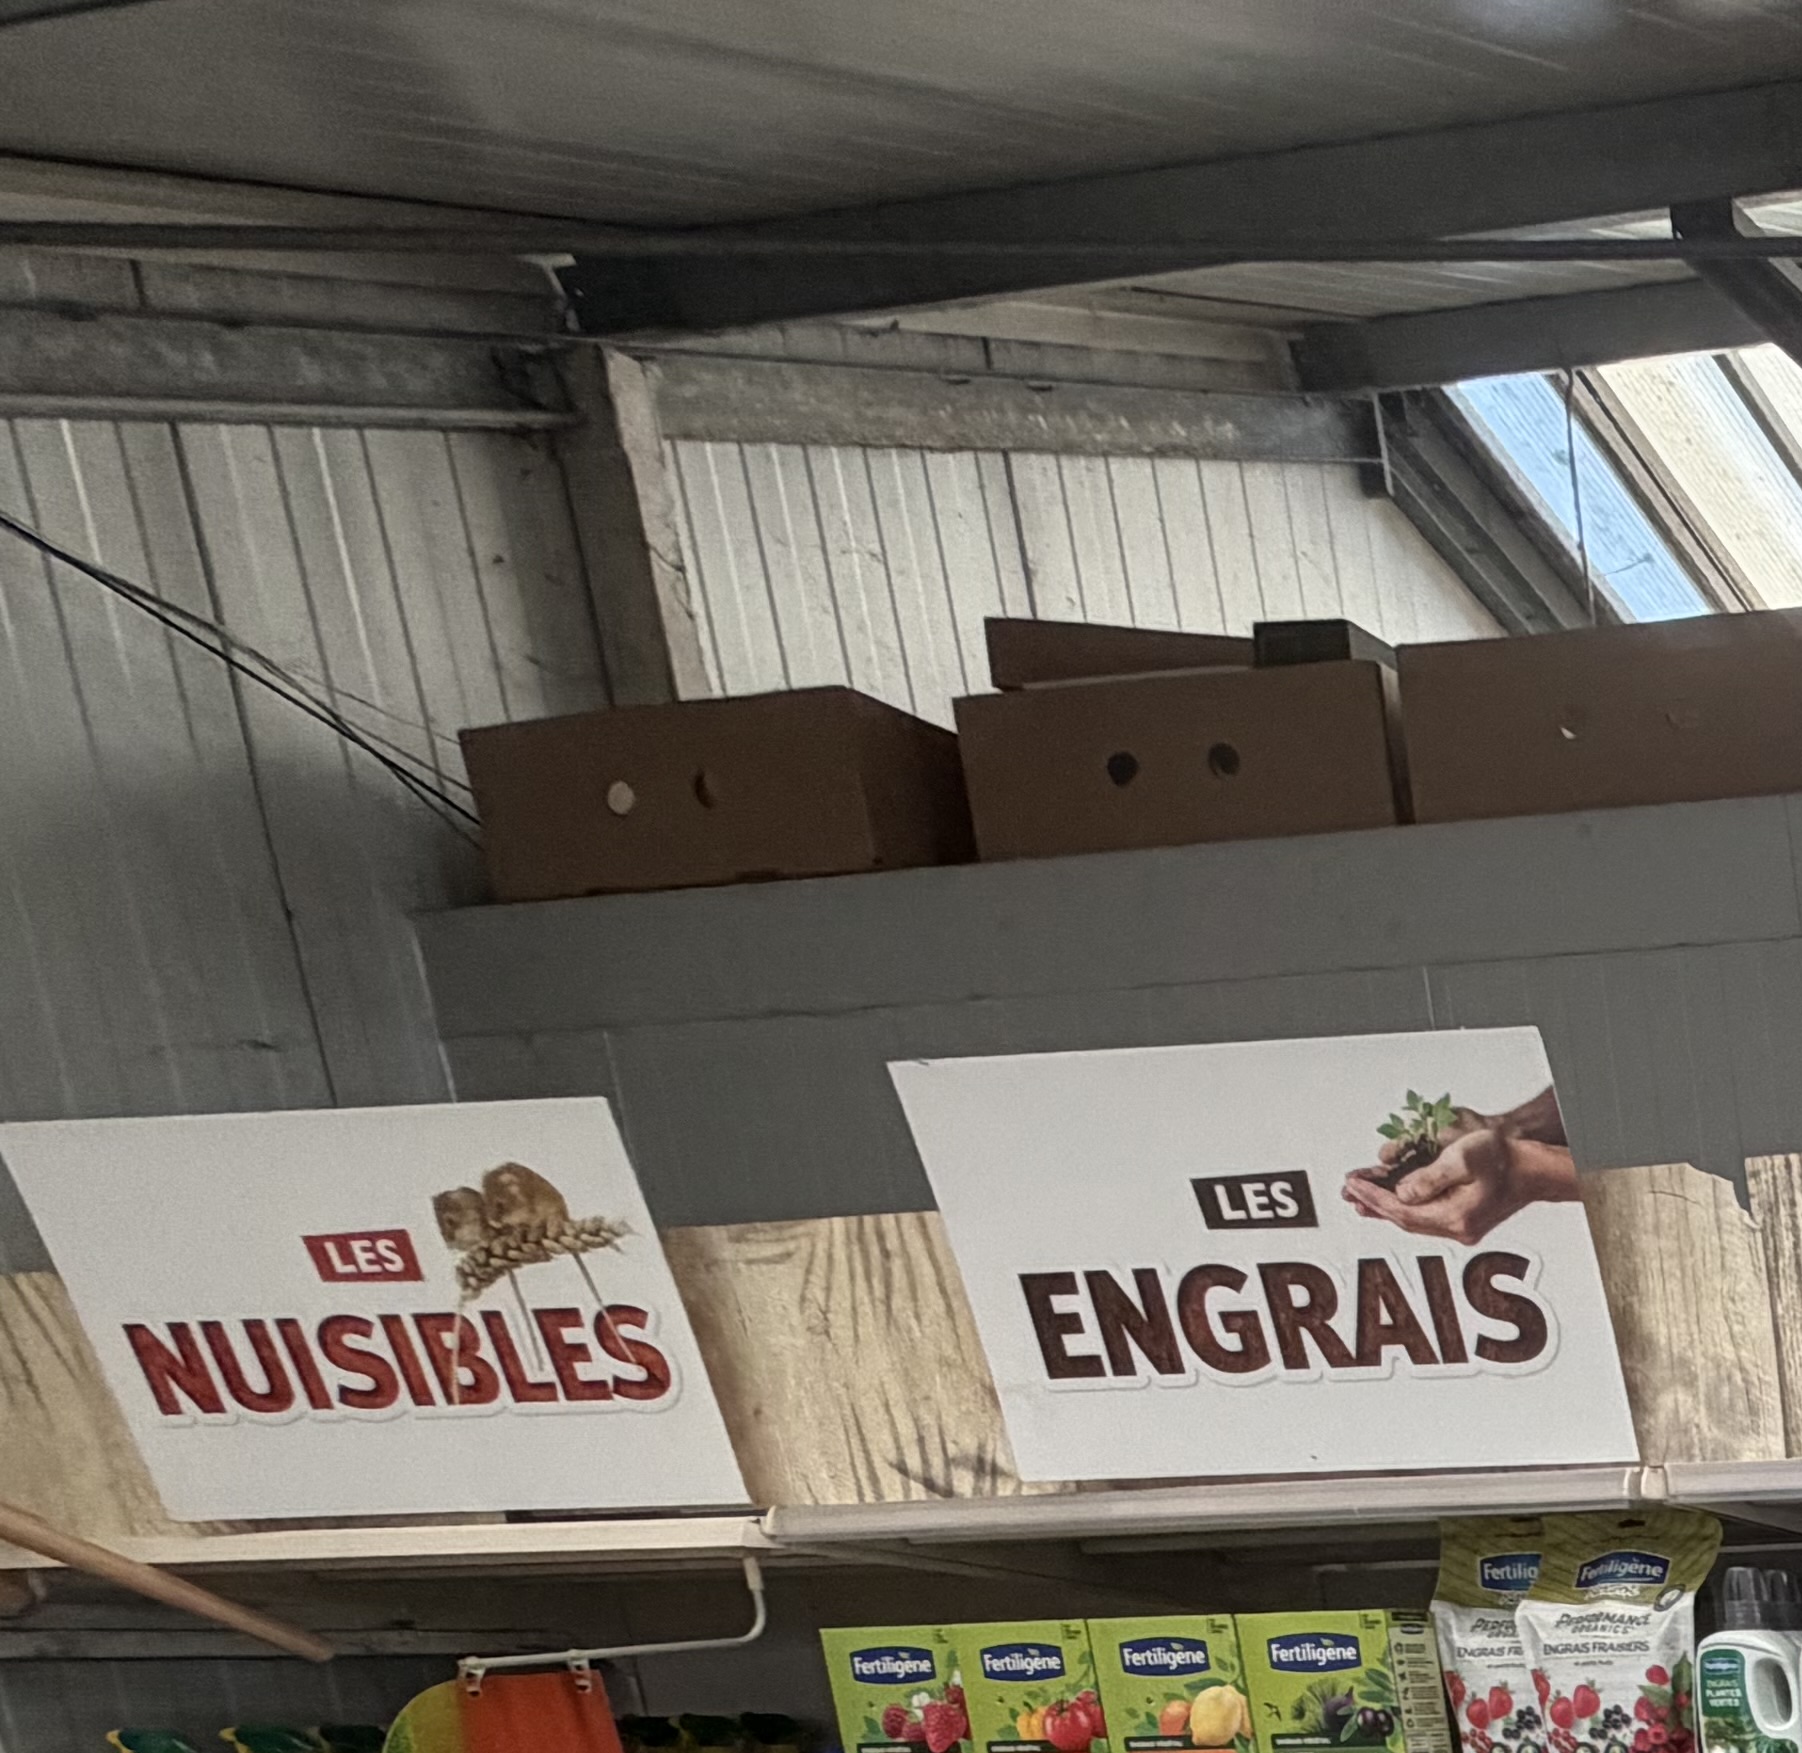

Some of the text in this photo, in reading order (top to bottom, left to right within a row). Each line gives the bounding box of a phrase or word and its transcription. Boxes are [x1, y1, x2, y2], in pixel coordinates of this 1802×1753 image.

[1214, 1182, 1299, 1221] LES
[330, 1240, 405, 1274] LES
[1019, 1251, 1549, 1380] ENGRAIS
[123, 1305, 671, 1416] NUISIBLES
[1581, 1558, 1663, 1580] Fertiligène
[1123, 1646, 1205, 1670] Fertiligène
[1271, 1642, 1357, 1666] Fertiligène
